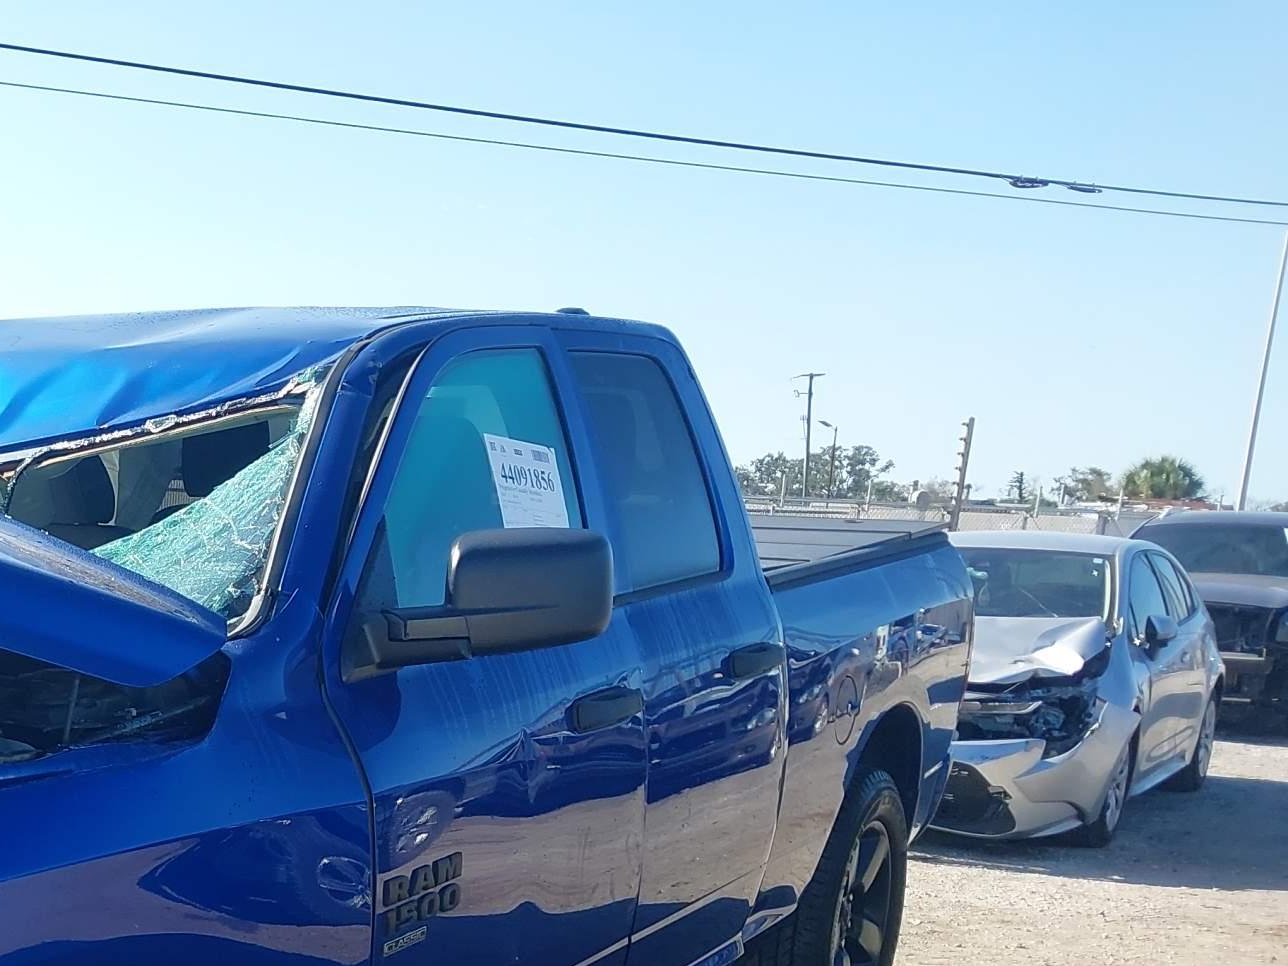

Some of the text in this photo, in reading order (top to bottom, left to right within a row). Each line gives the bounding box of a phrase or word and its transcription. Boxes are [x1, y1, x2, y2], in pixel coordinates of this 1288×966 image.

[500, 463, 555, 492] 44091856
[383, 851, 463, 907] RAM
[386, 883, 461, 936] 1500
[385, 928, 426, 954] CLASSIC
